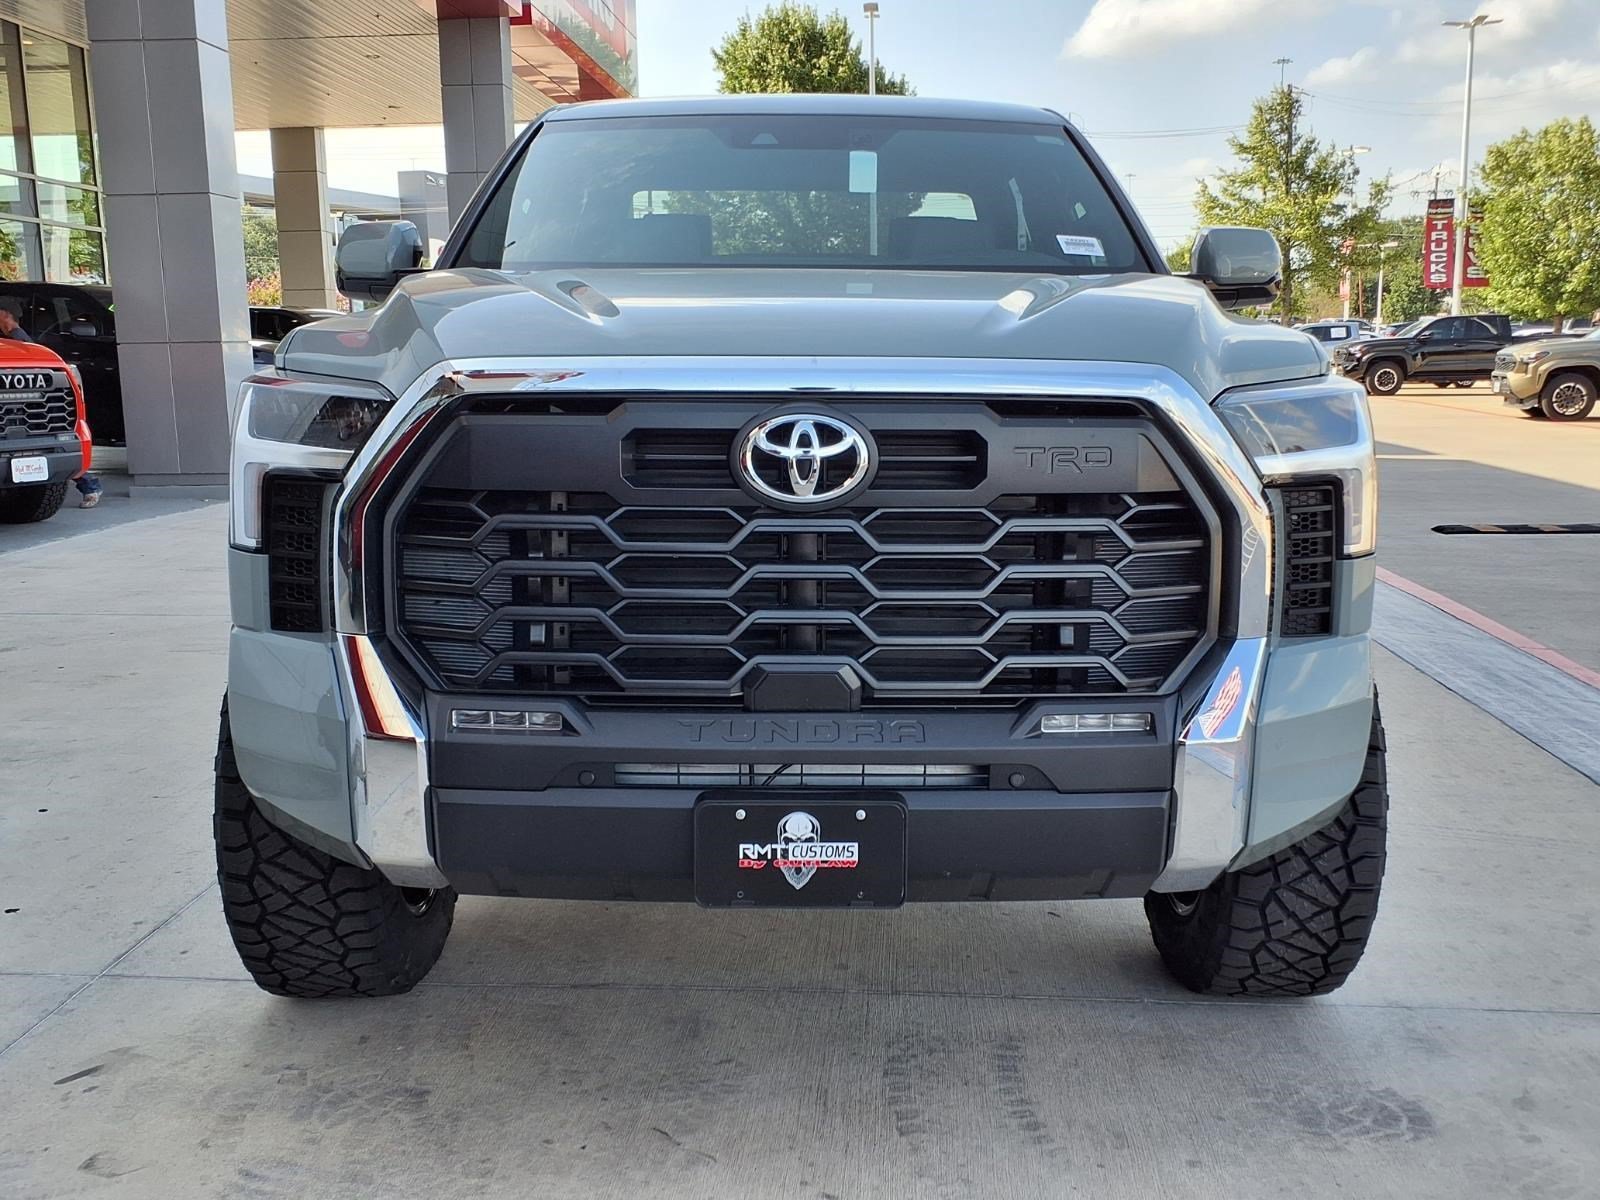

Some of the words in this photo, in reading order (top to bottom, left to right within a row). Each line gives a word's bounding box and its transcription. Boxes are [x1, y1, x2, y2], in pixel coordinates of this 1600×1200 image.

[1430, 220, 1449, 283] TRUCKS
[2, 374, 46, 389] YOTA
[1013, 446, 1112, 474] TRD
[677, 719, 926, 743] TUNDRA
[739, 843, 788, 860] RMT
[791, 844, 855, 859] CUSTOMS
[772, 859, 859, 869] OUTLAW
